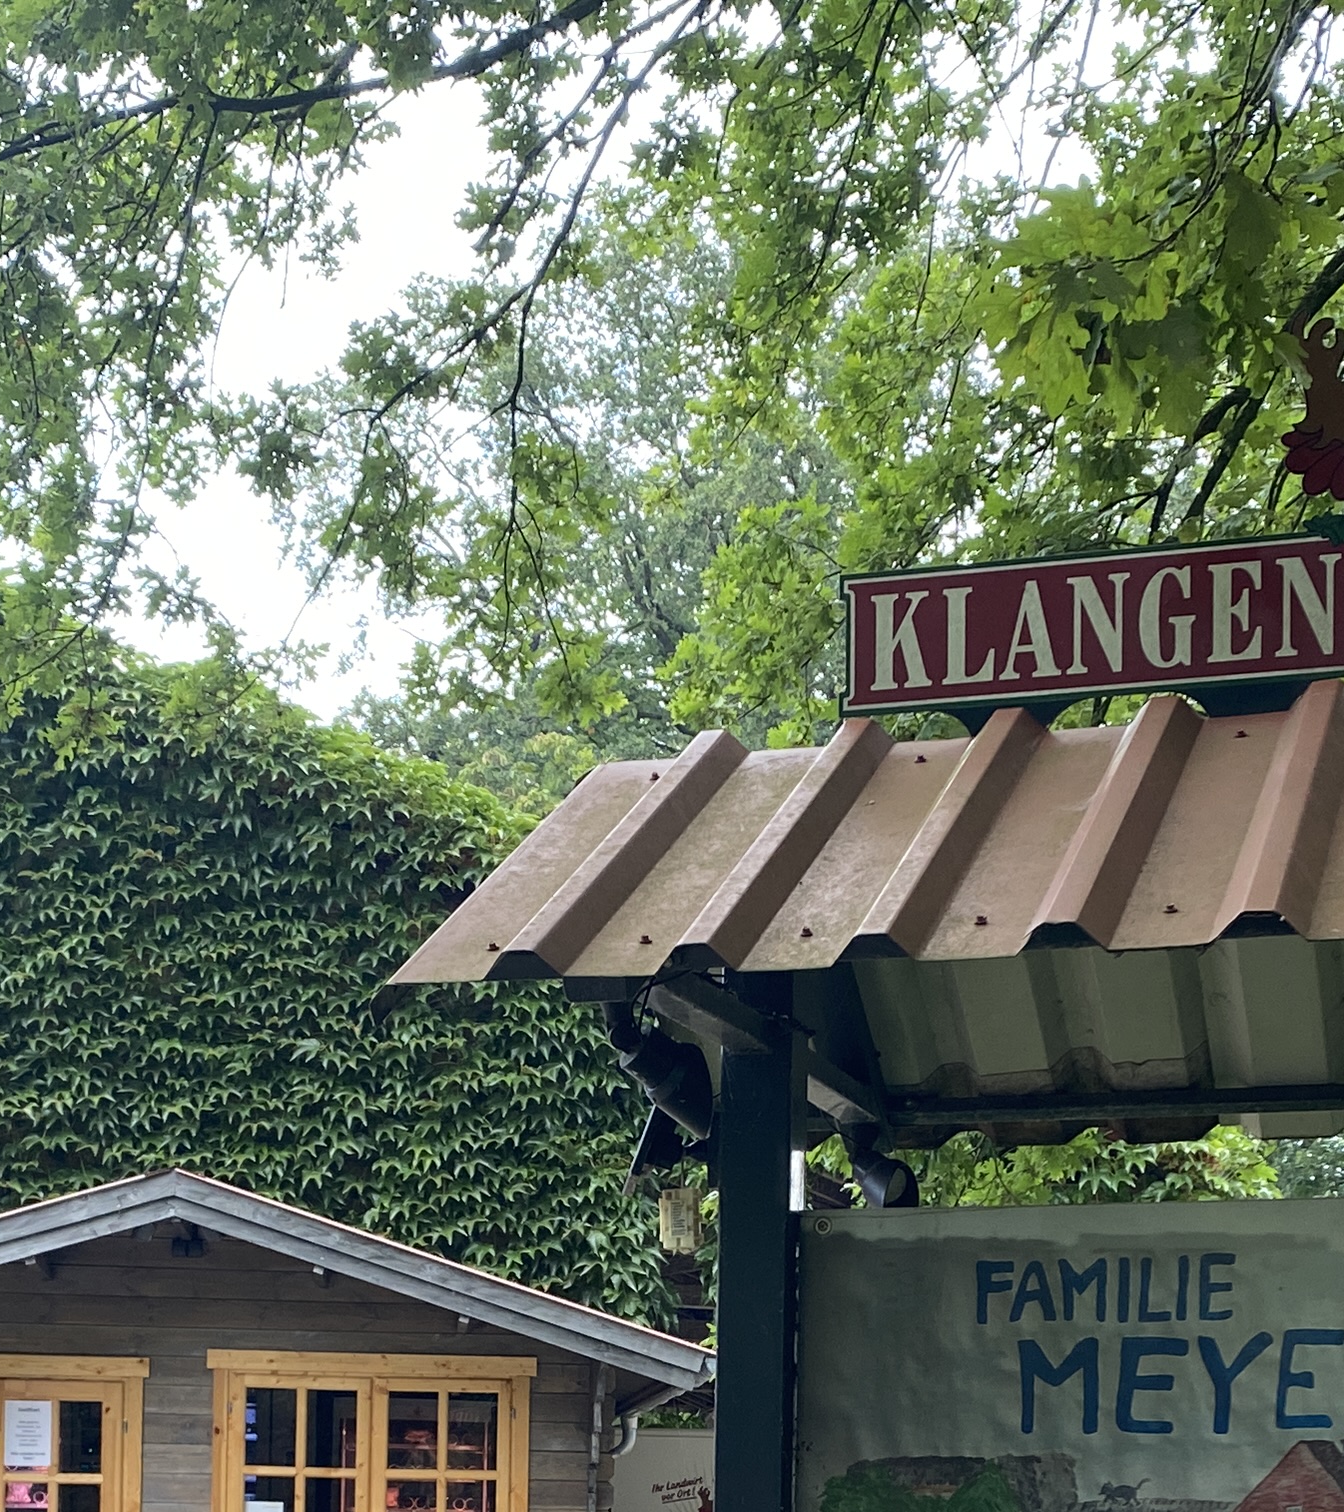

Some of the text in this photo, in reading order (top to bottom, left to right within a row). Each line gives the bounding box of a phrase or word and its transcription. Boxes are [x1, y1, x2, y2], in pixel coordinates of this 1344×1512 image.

[976, 1253, 1236, 1324] FAMILIE
[651, 1476, 703, 1493] Ihr Landwirt
[661, 1486, 696, 1501] vor Ort!
